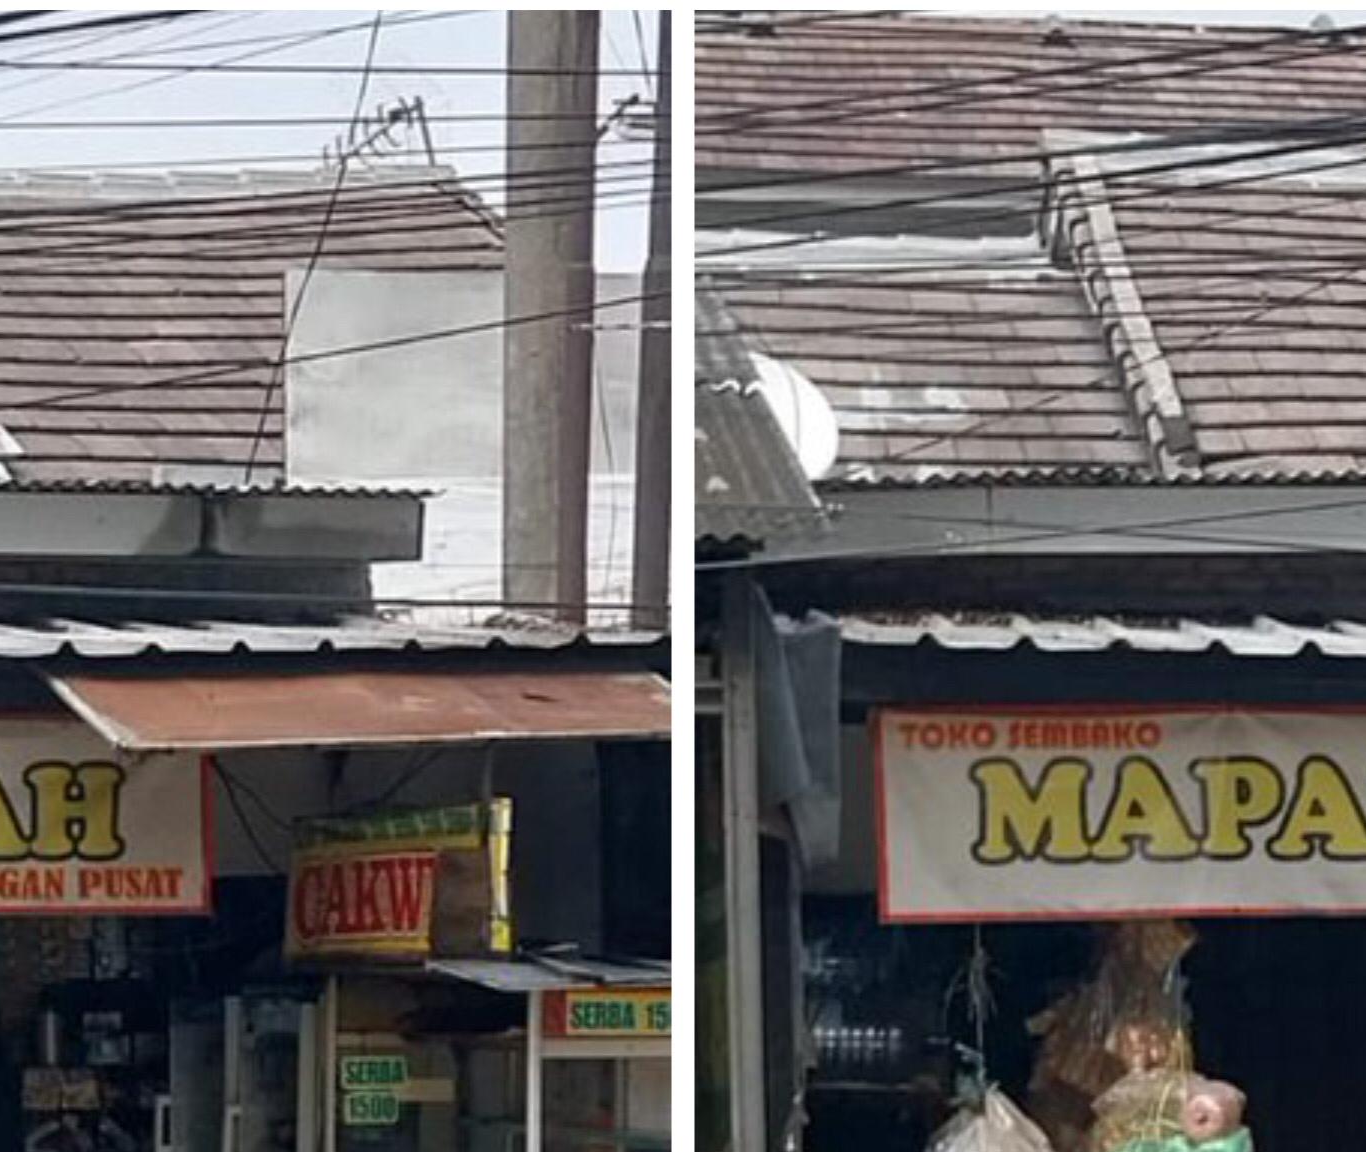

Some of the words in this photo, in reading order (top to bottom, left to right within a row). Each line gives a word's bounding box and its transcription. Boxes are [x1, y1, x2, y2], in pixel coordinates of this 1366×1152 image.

[897, 722, 995, 749] TOKO
[1007, 720, 1161, 750] SEMBAKO
[79, 867, 185, 897] PUSAT
[569, 1000, 635, 1029] SERBA
